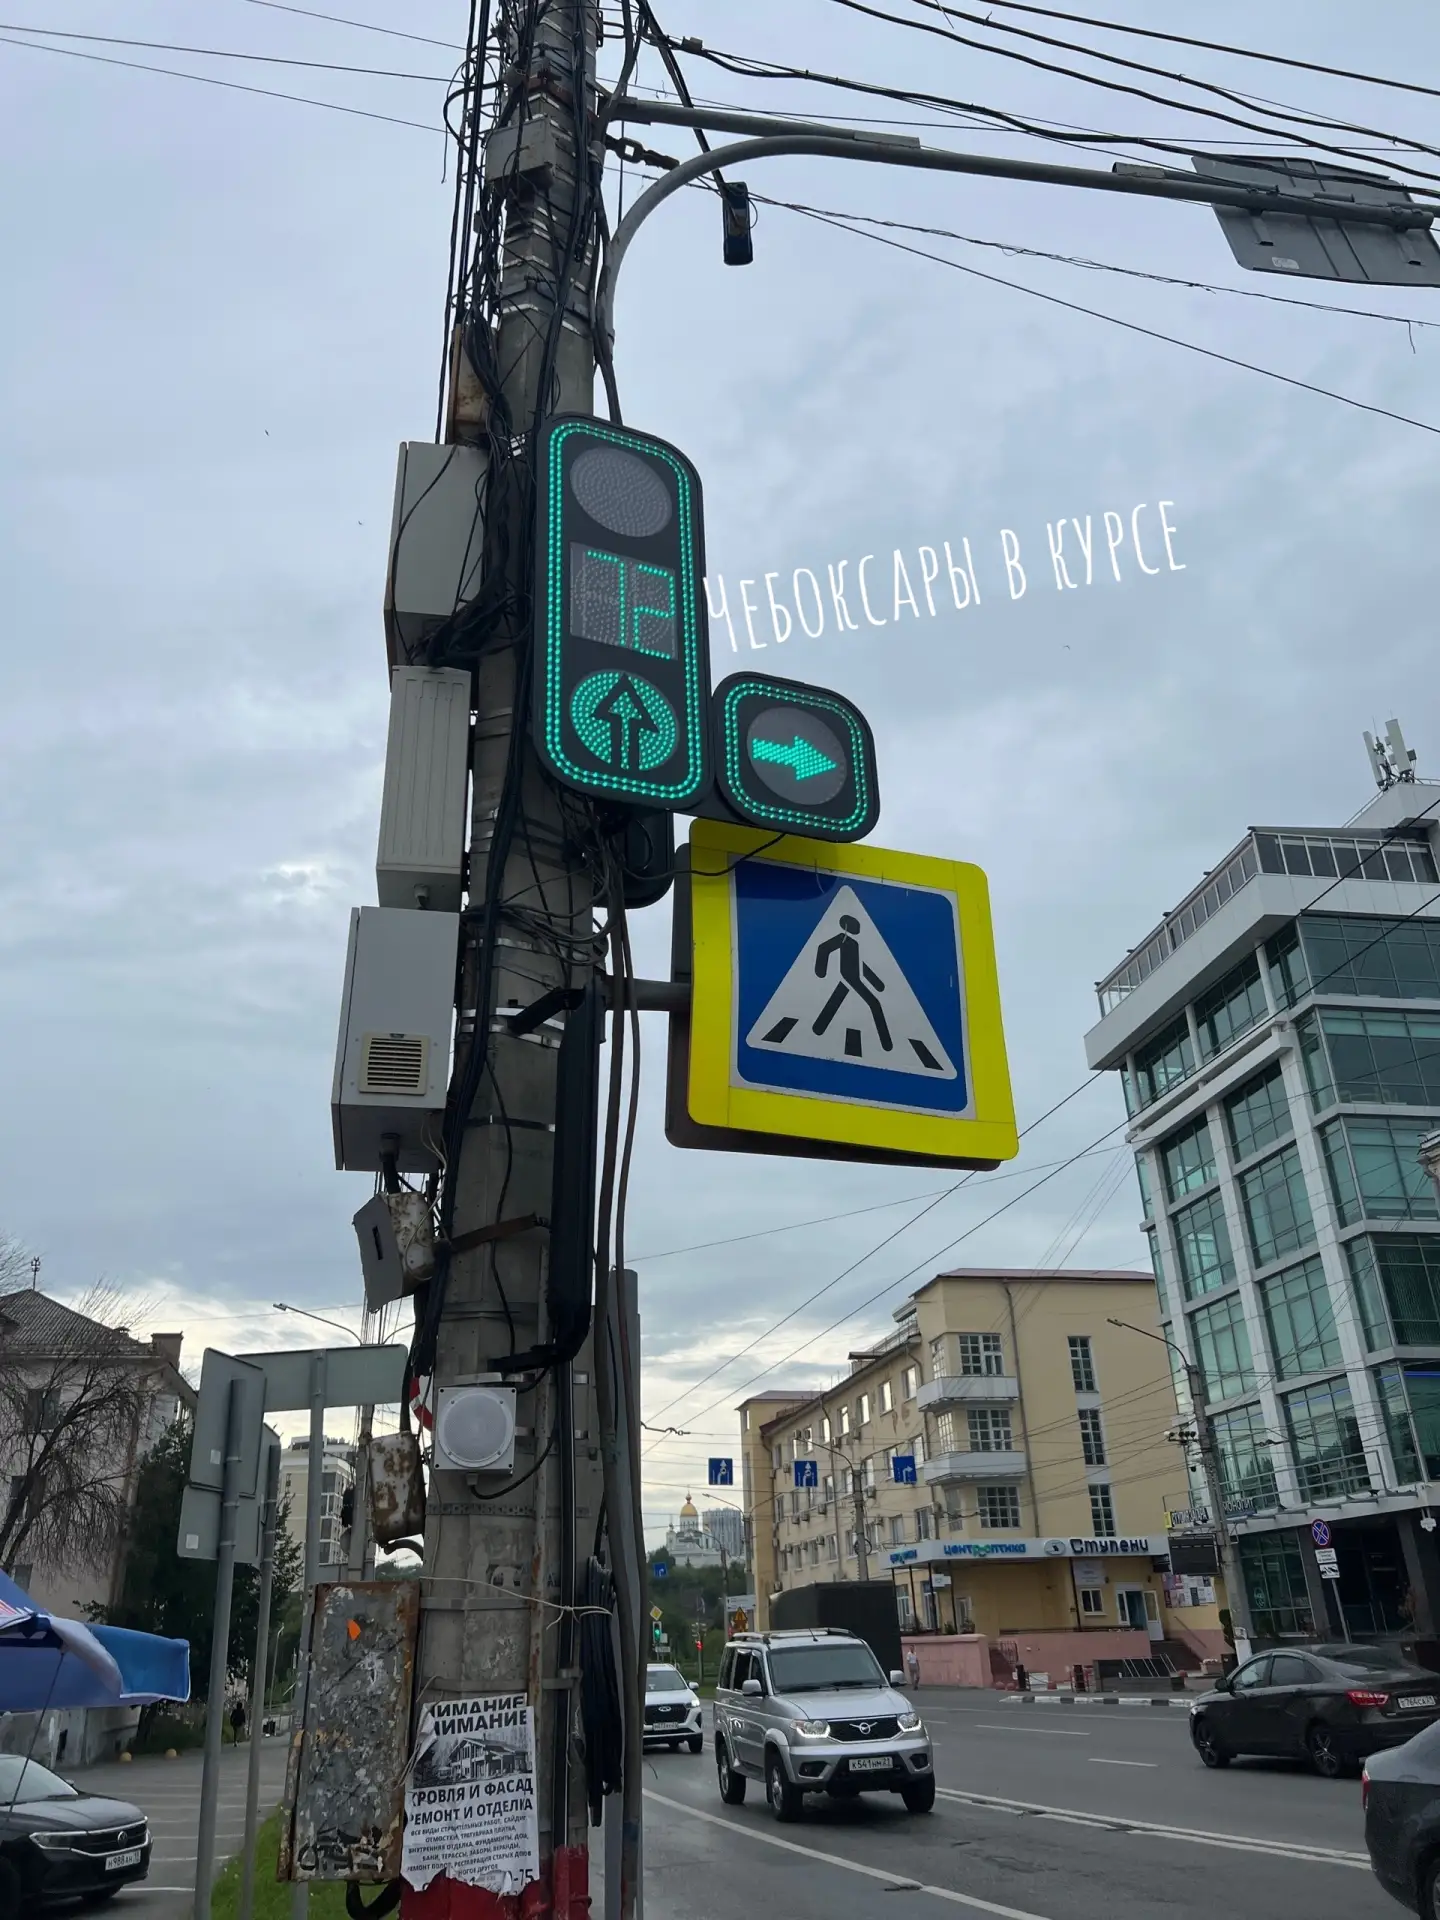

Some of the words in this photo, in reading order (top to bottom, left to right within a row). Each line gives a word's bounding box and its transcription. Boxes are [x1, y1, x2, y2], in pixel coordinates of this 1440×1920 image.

[586, 550, 676, 659] 72
[1070, 1538, 1149, 1554] Ступени
[469, 1784, 480, 1799] И
[484, 1778, 533, 1796] ФАСАД
[463, 1805, 473, 1819] И
[476, 1797, 533, 1818] ОТДЕЛКА
